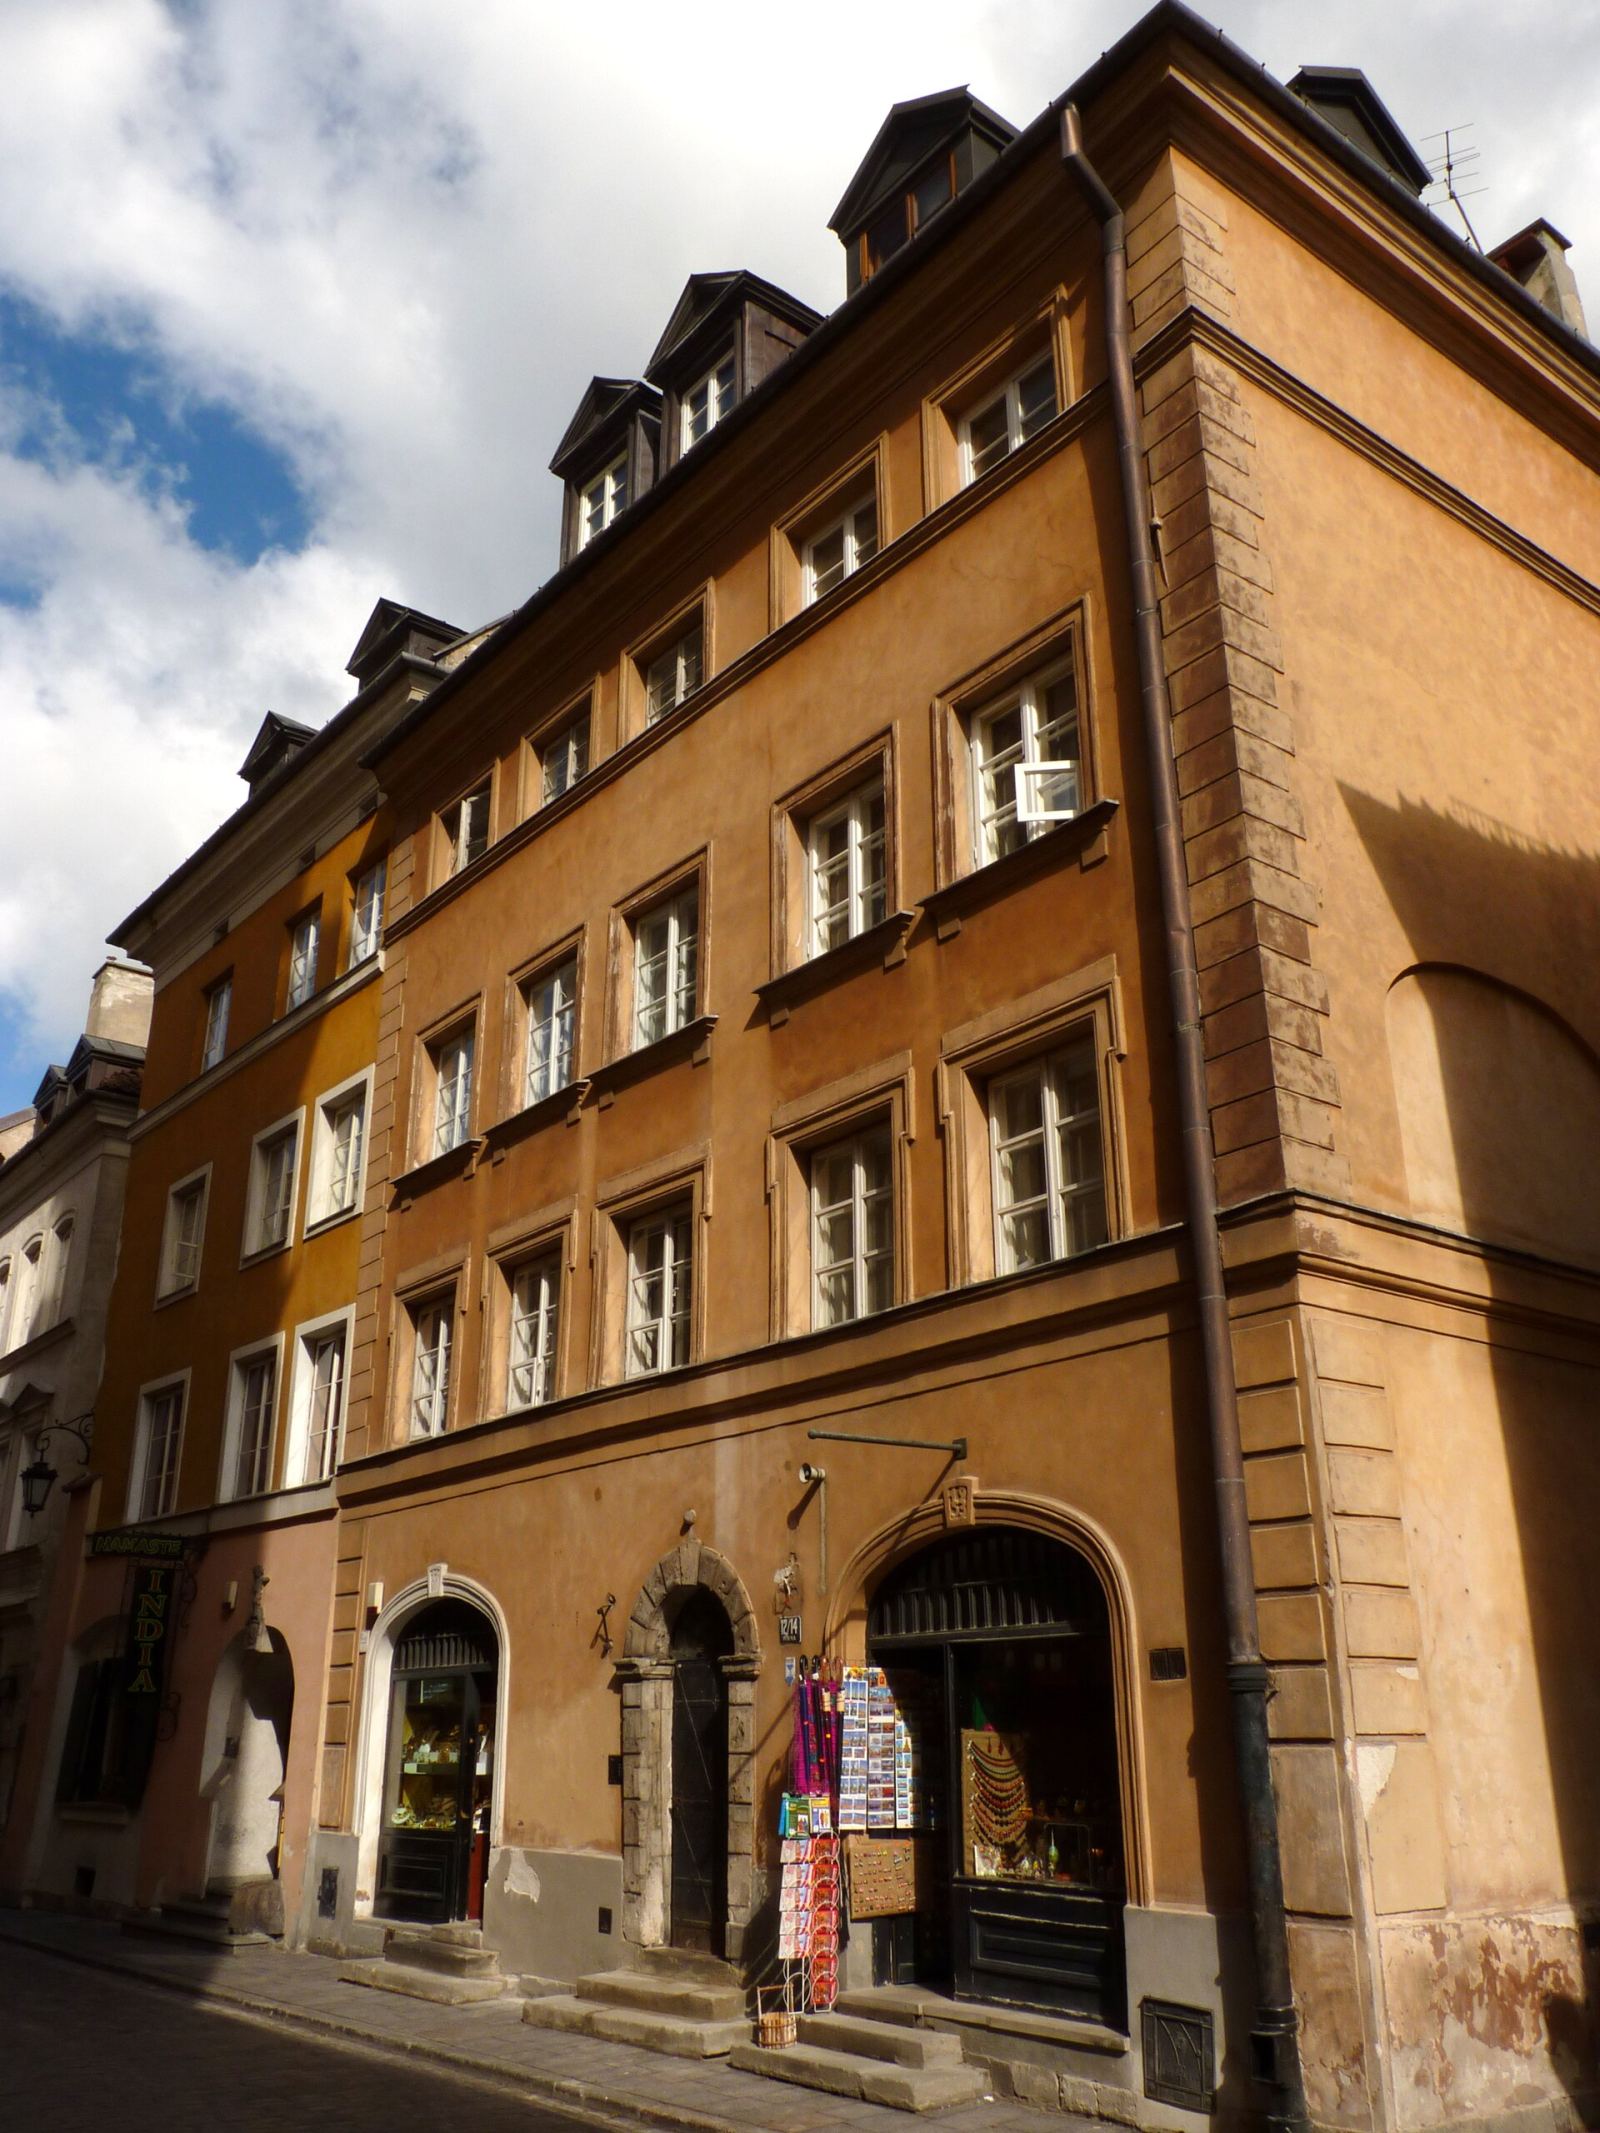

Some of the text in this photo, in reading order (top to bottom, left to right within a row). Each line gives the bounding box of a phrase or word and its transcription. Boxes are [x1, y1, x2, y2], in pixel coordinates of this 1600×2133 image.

[95, 1536, 181, 1555] NAMASTE
[127, 1569, 168, 1694] INDIA
[780, 1618, 798, 1635] 12/14
